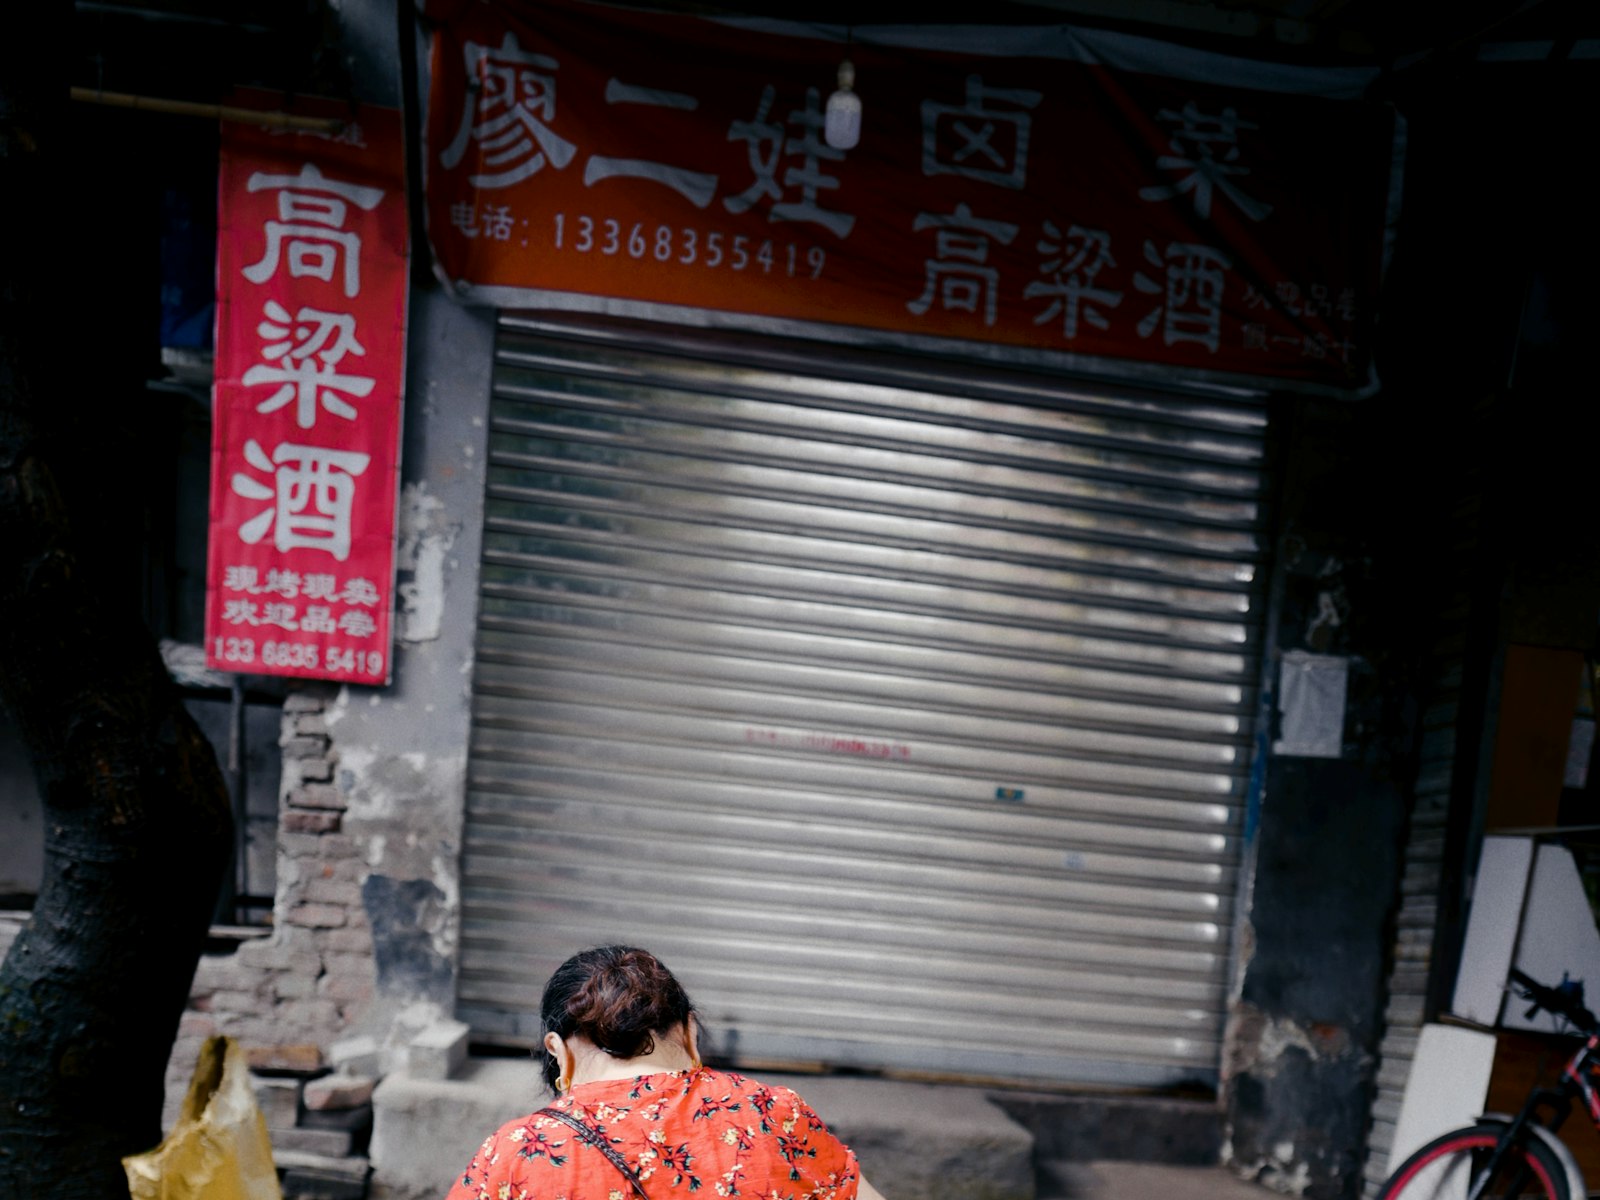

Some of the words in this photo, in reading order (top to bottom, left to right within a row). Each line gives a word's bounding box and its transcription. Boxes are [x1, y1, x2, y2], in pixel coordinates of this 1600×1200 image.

[439, 31, 858, 241] 廖二娃
[552, 213, 827, 281] 13368355419
[905, 201, 1232, 354] 高粱酒
[231, 161, 387, 562] 高粱酒
[214, 636, 255, 663] 133
[325, 646, 383, 676] 5419
[221, 598, 377, 638] 欢迎品尝
